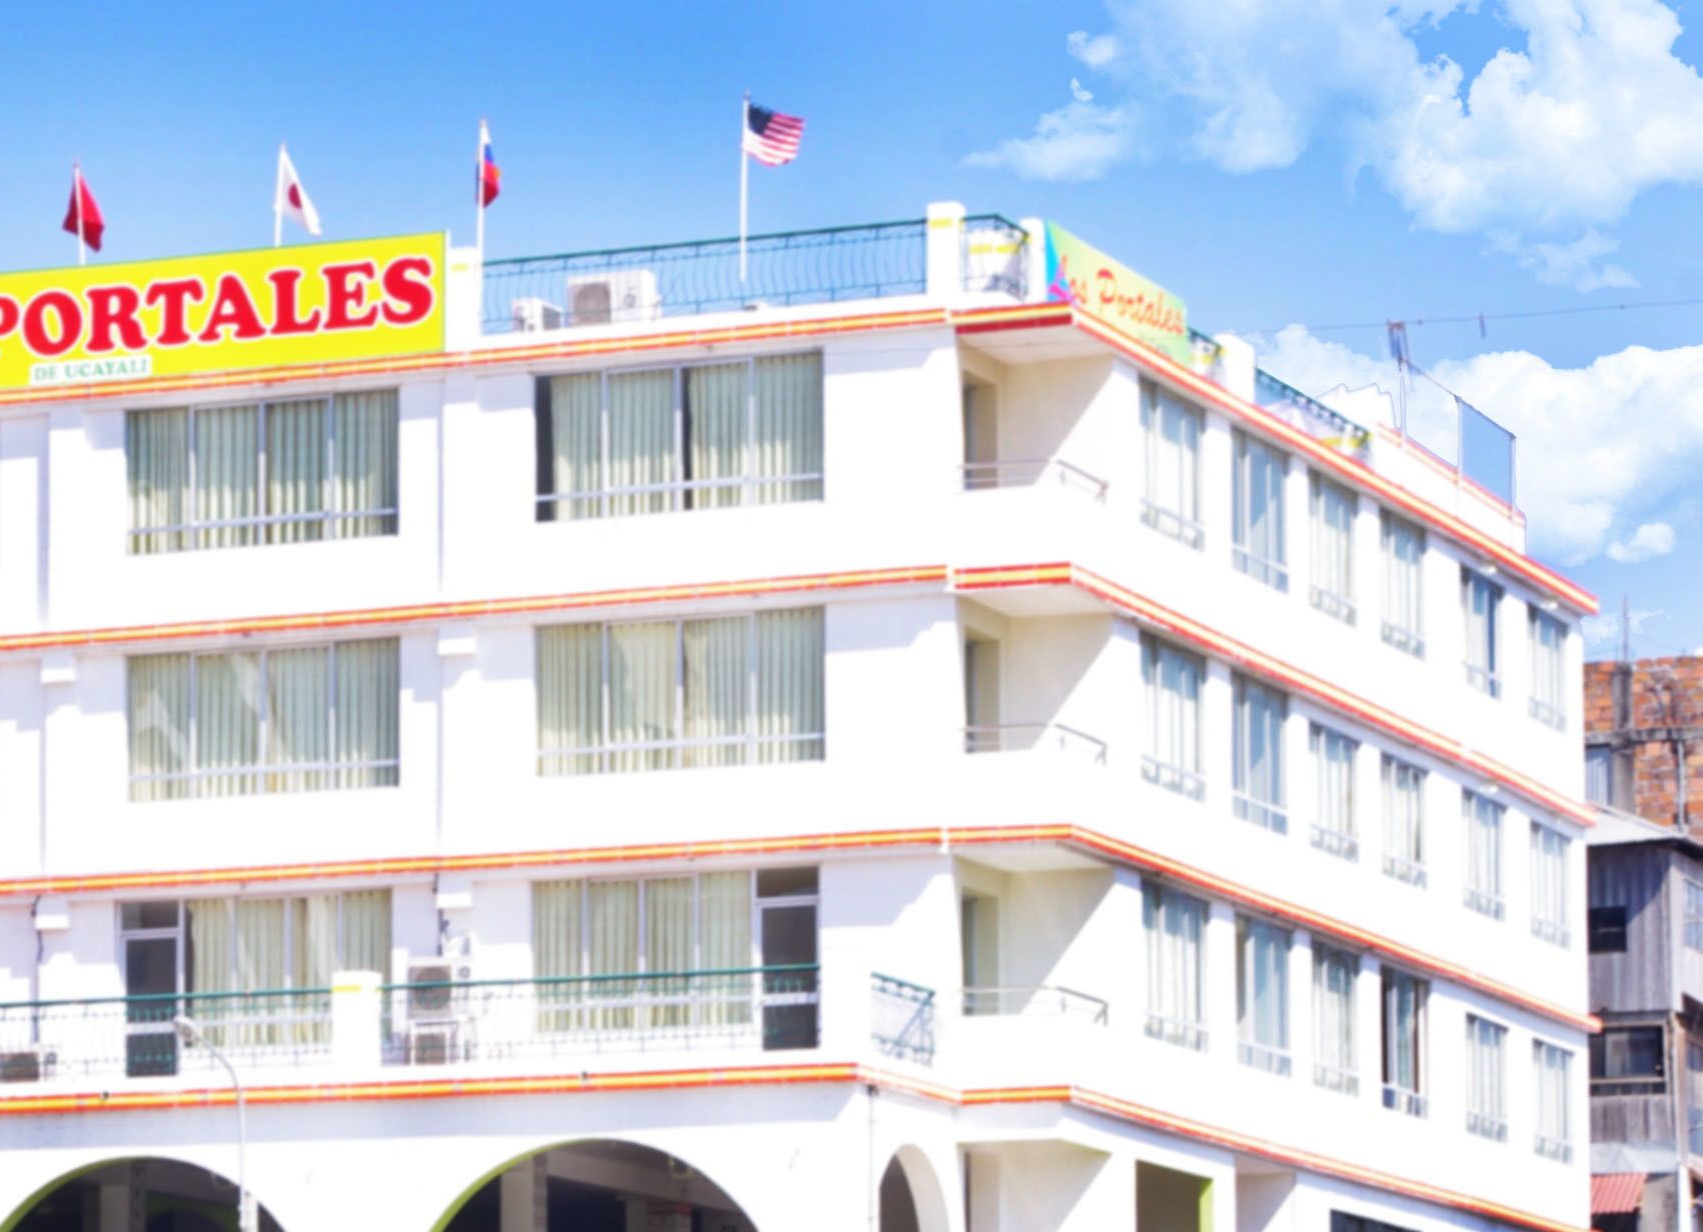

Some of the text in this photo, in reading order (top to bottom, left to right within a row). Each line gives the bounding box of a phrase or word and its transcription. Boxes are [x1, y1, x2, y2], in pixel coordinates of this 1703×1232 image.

[1097, 268, 1184, 335] Portales
[34, 358, 148, 381] DE UCAYALI
